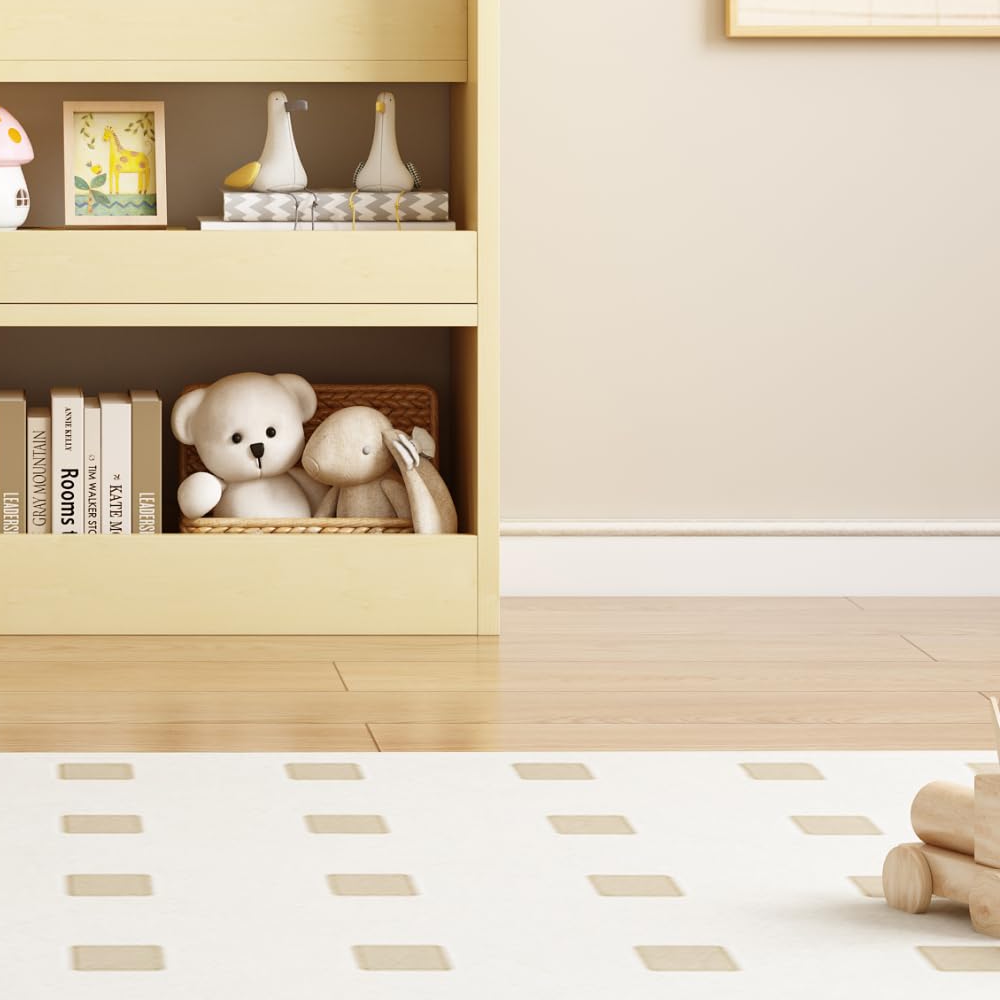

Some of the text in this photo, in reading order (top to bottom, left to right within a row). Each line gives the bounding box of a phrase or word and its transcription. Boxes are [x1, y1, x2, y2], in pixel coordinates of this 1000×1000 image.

[33, 430, 46, 527] GRAY MOUNTAIN
[88, 465, 97, 480] TIM
[3, 492, 19, 534] LEADERS
[61, 468, 79, 526] Rooms
[88, 482, 97, 518] WALKER
[109, 485, 123, 534] KATE M
[139, 492, 155, 534] LEADERS
